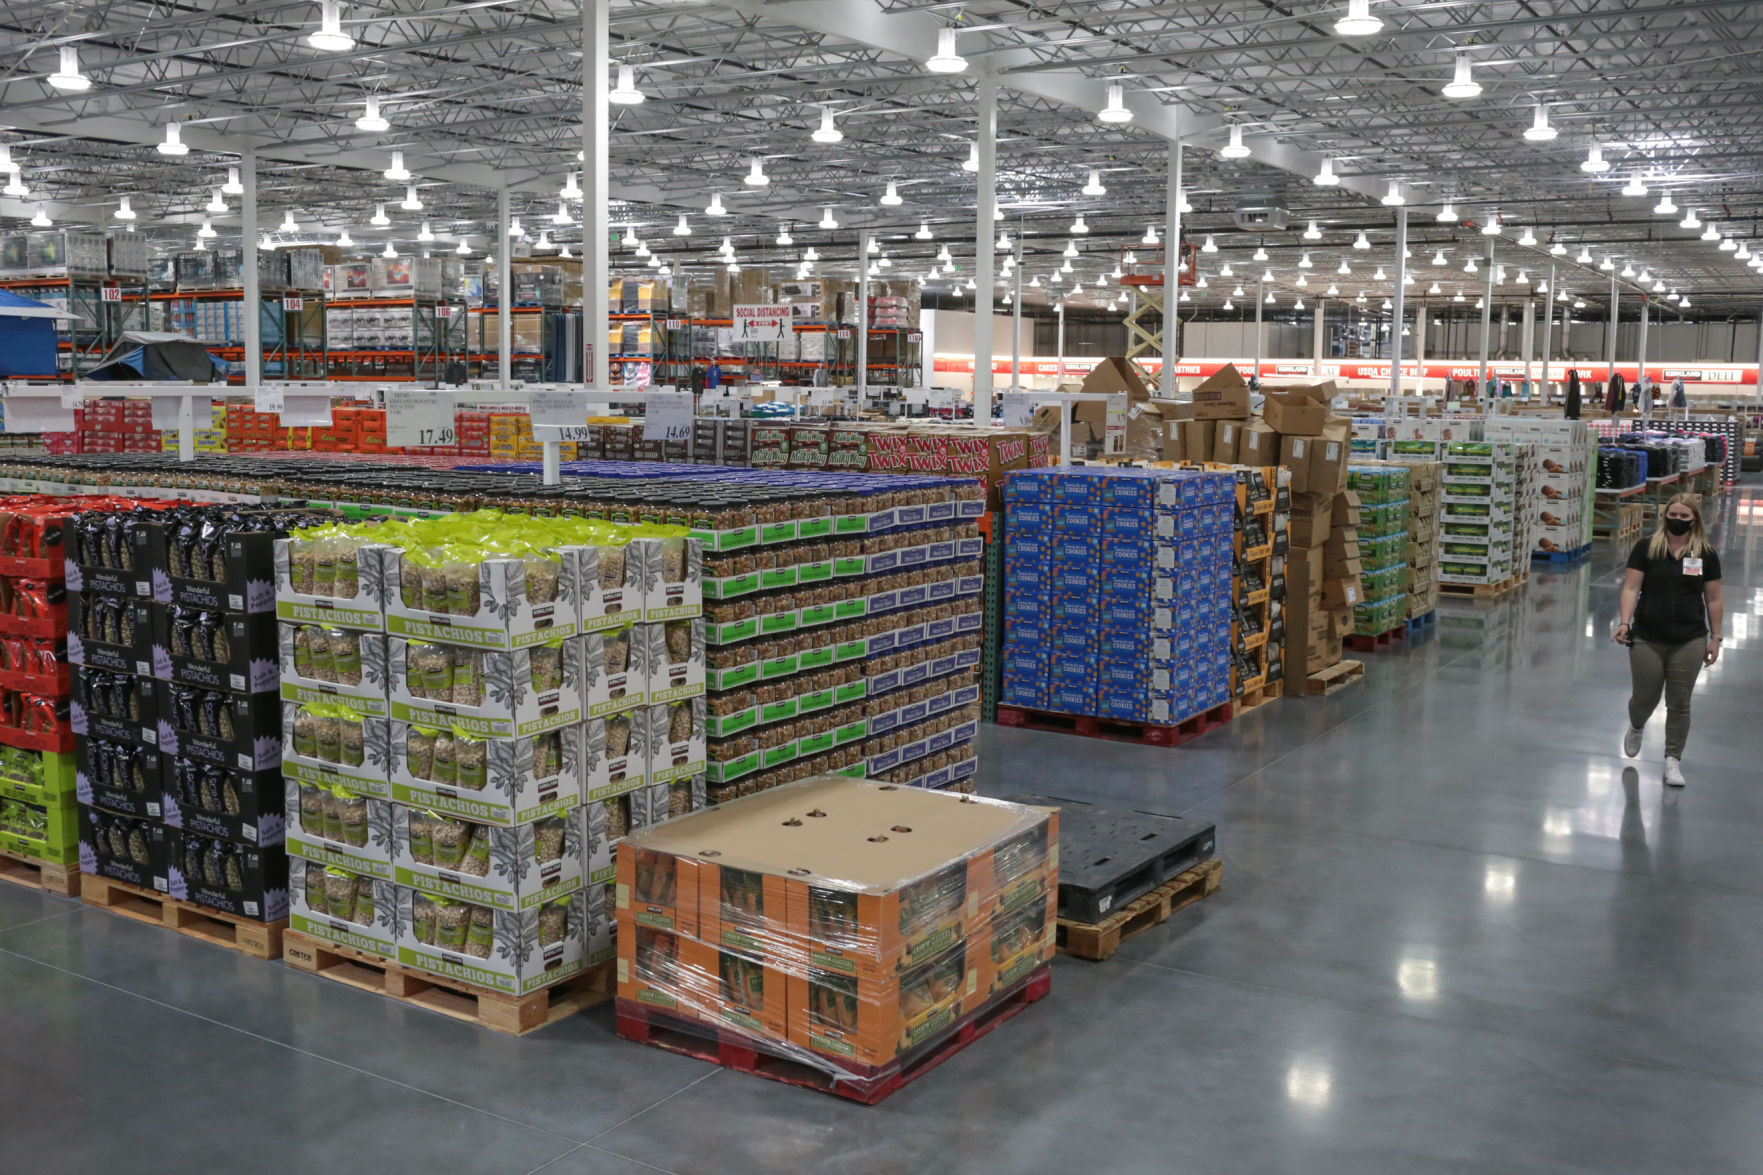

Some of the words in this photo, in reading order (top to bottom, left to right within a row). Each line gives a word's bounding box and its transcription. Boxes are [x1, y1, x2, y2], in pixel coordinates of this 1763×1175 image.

[104, 289, 120, 300] 102
[286, 299, 300, 309] 104
[438, 307, 450, 317] 106
[736, 308, 755, 317] SOCIAL
[757, 307, 789, 317] DISTANCING
[1358, 368, 1378, 376] USDA
[1709, 372, 1734, 380] DELI
[419, 429, 453, 444] 17.49
[559, 426, 588, 440] 14.99
[666, 426, 690, 439] 14.69
[869, 435, 907, 451] TWIX
[909, 435, 948, 453] TWIX
[950, 438, 989, 455] TWIX
[868, 452, 907, 470] TWIX
[907, 453, 947, 471] TWIX
[949, 456, 990, 473] TWIX
[90, 580, 125, 592] PISTACHIOS
[180, 592, 218, 606] PISTACHIOS
[293, 605, 360, 624] PISTACHIOS
[588, 612, 638, 627] PISTACHIOS
[650, 606, 697, 618] PISTACHIOS
[405, 621, 483, 642] PISTACHIOS
[515, 625, 571, 646] PISTACHIOS
[91, 655, 127, 668] PISTACHIOS
[181, 669, 219, 685] PISTACHIOS
[296, 688, 365, 710] PISTACHIOS
[655, 684, 700, 700] PISTACHIOS
[593, 695, 641, 713] PISTACHIOS
[409, 709, 488, 732] PISTACHIOS
[523, 712, 576, 734] PISTACHIOS
[95, 725, 130, 739] PISTACHIOS
[187, 745, 224, 761] PISTACHIOS
[297, 766, 367, 791] PISTACHIOS
[656, 763, 701, 780] PISTACHIOS
[593, 778, 641, 796] PISTACHIOS
[99, 798, 135, 812] PISTACHIOS
[410, 790, 488, 816] PISTACHIOS
[521, 798, 574, 820] PISTACHIOS
[190, 820, 228, 837] PISTACHIOS
[303, 845, 370, 872] PISTACHIOS
[104, 866, 141, 883] PISTACHIOS
[413, 874, 492, 904] PISTACHIOS
[525, 880, 577, 906] PISTACHIOS
[195, 892, 234, 911] PISTACHIOS
[308, 921, 376, 950] PISTACHIOS
[289, 948, 311, 962] COSTCO
[416, 955, 494, 986] PISTACHIOS
[526, 962, 579, 988] PISTACHIOS
